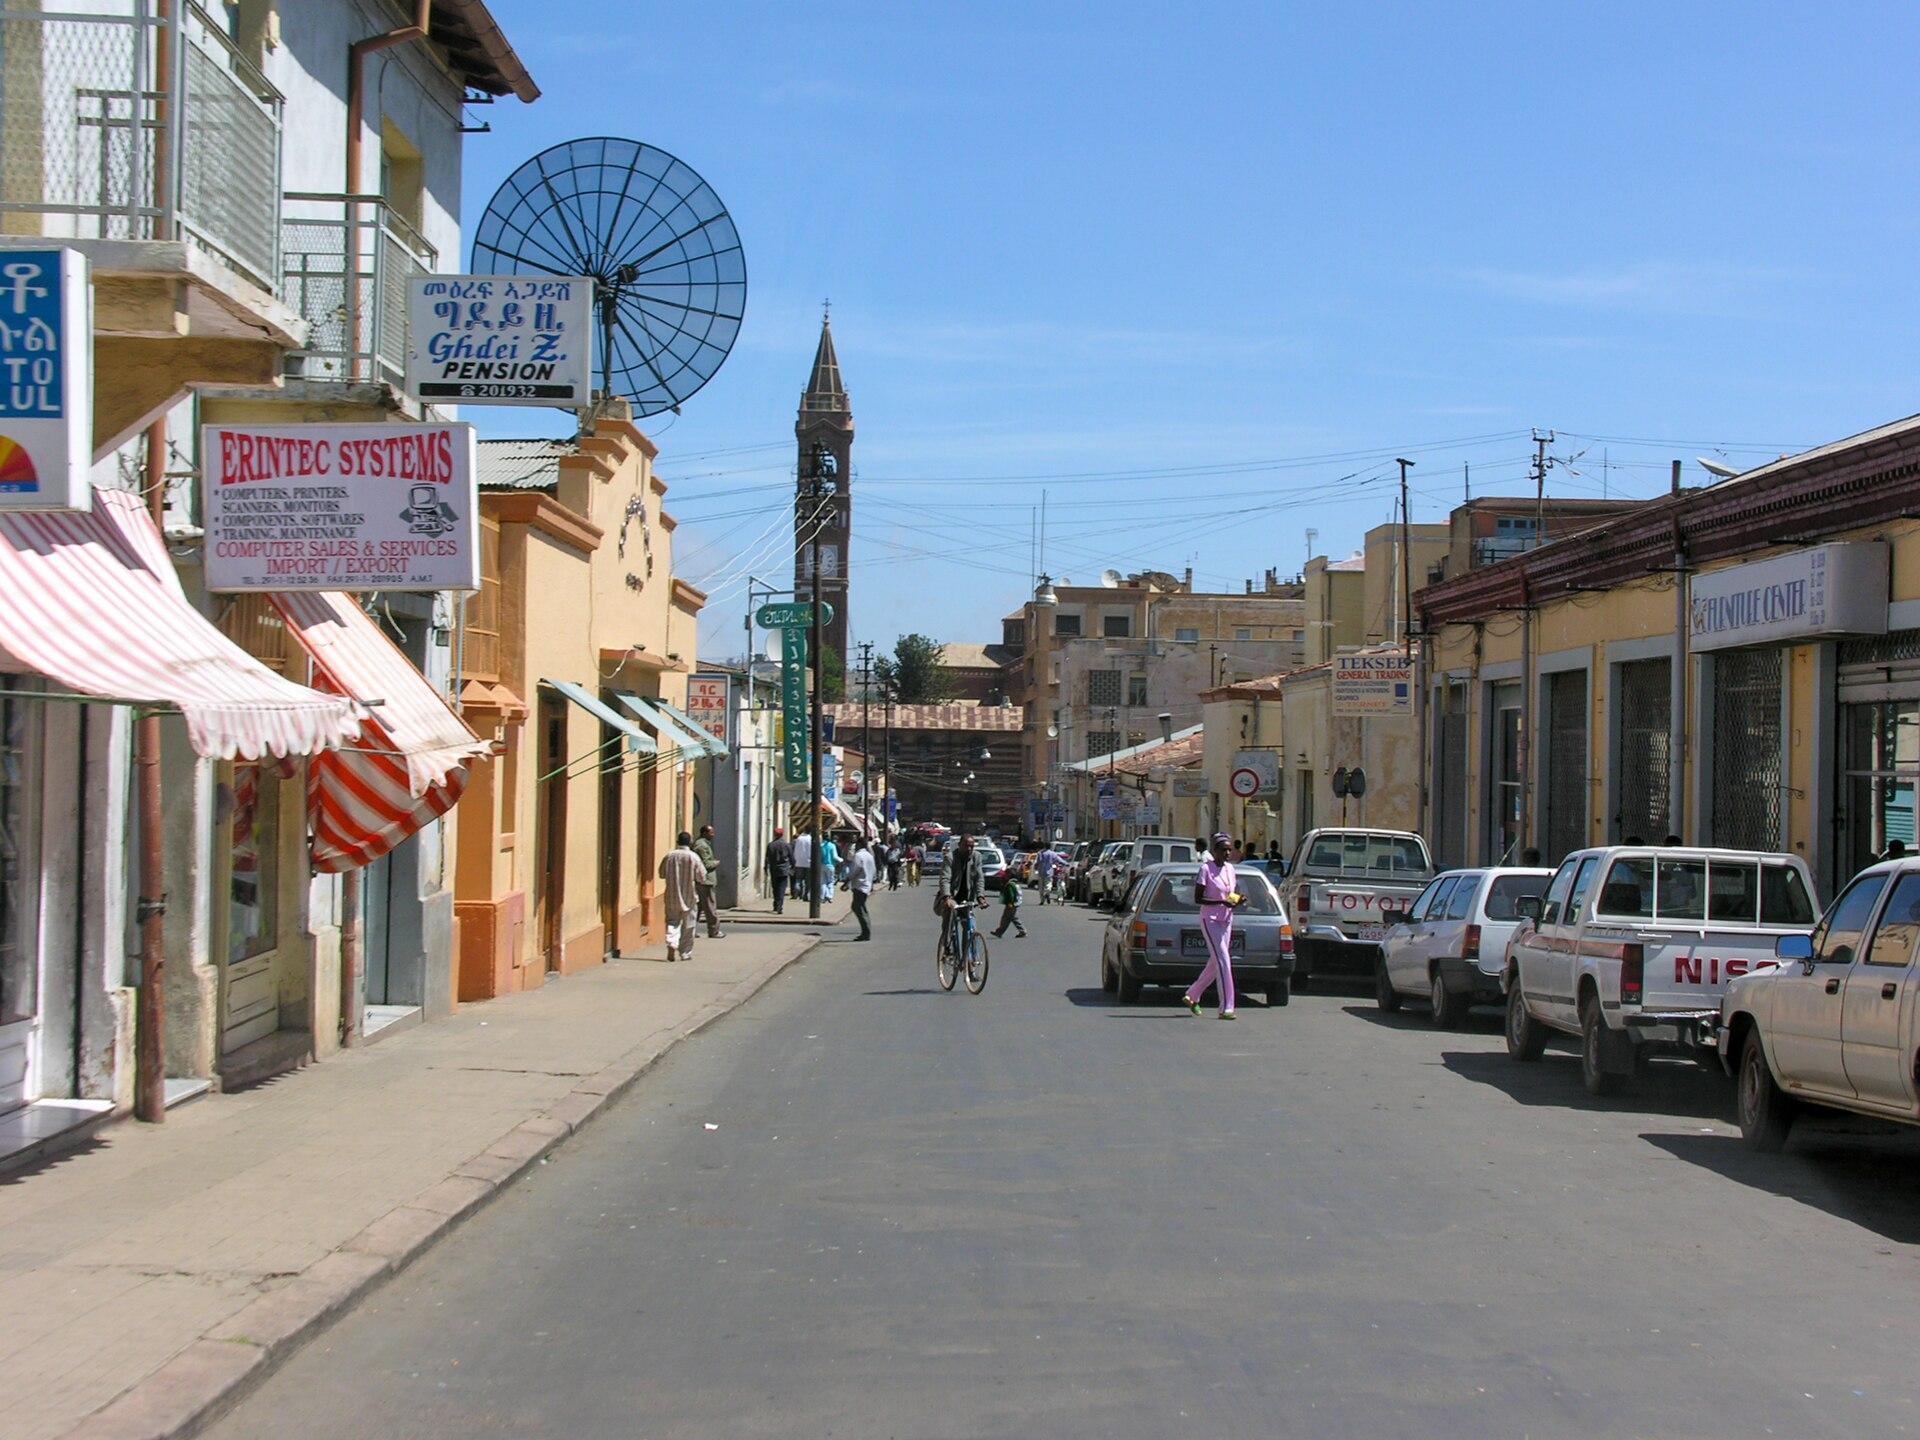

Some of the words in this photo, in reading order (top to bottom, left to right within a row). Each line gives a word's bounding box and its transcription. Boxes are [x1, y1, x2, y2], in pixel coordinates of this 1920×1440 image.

[428, 332, 520, 364] Ghdei
[530, 333, 568, 362] Z.
[3, 357, 54, 386] TO
[442, 362, 556, 380] PENSION
[478, 385, 537, 398] 201932
[219, 431, 331, 486] ERINTEC
[339, 430, 452, 485] SYSTEMS
[222, 487, 290, 500] COMPUTERS,
[222, 502, 282, 513] SCANNERS,
[284, 501, 341, 513] MONITORS
[302, 514, 365, 526] SOFTWARES
[280, 527, 358, 539] MAINTENANCE
[216, 541, 307, 558] COMPUTER
[310, 541, 359, 557] SALES
[364, 540, 374, 556] &
[379, 540, 458, 556] SERVICES
[267, 559, 328, 575] IMPORT
[333, 558, 340, 575] /
[346, 557, 410, 573] EXPORT
[1336, 671, 1371, 680] GENERAL
[1376, 670, 1410, 680] TRADING
[1675, 957, 1781, 985] NIS
